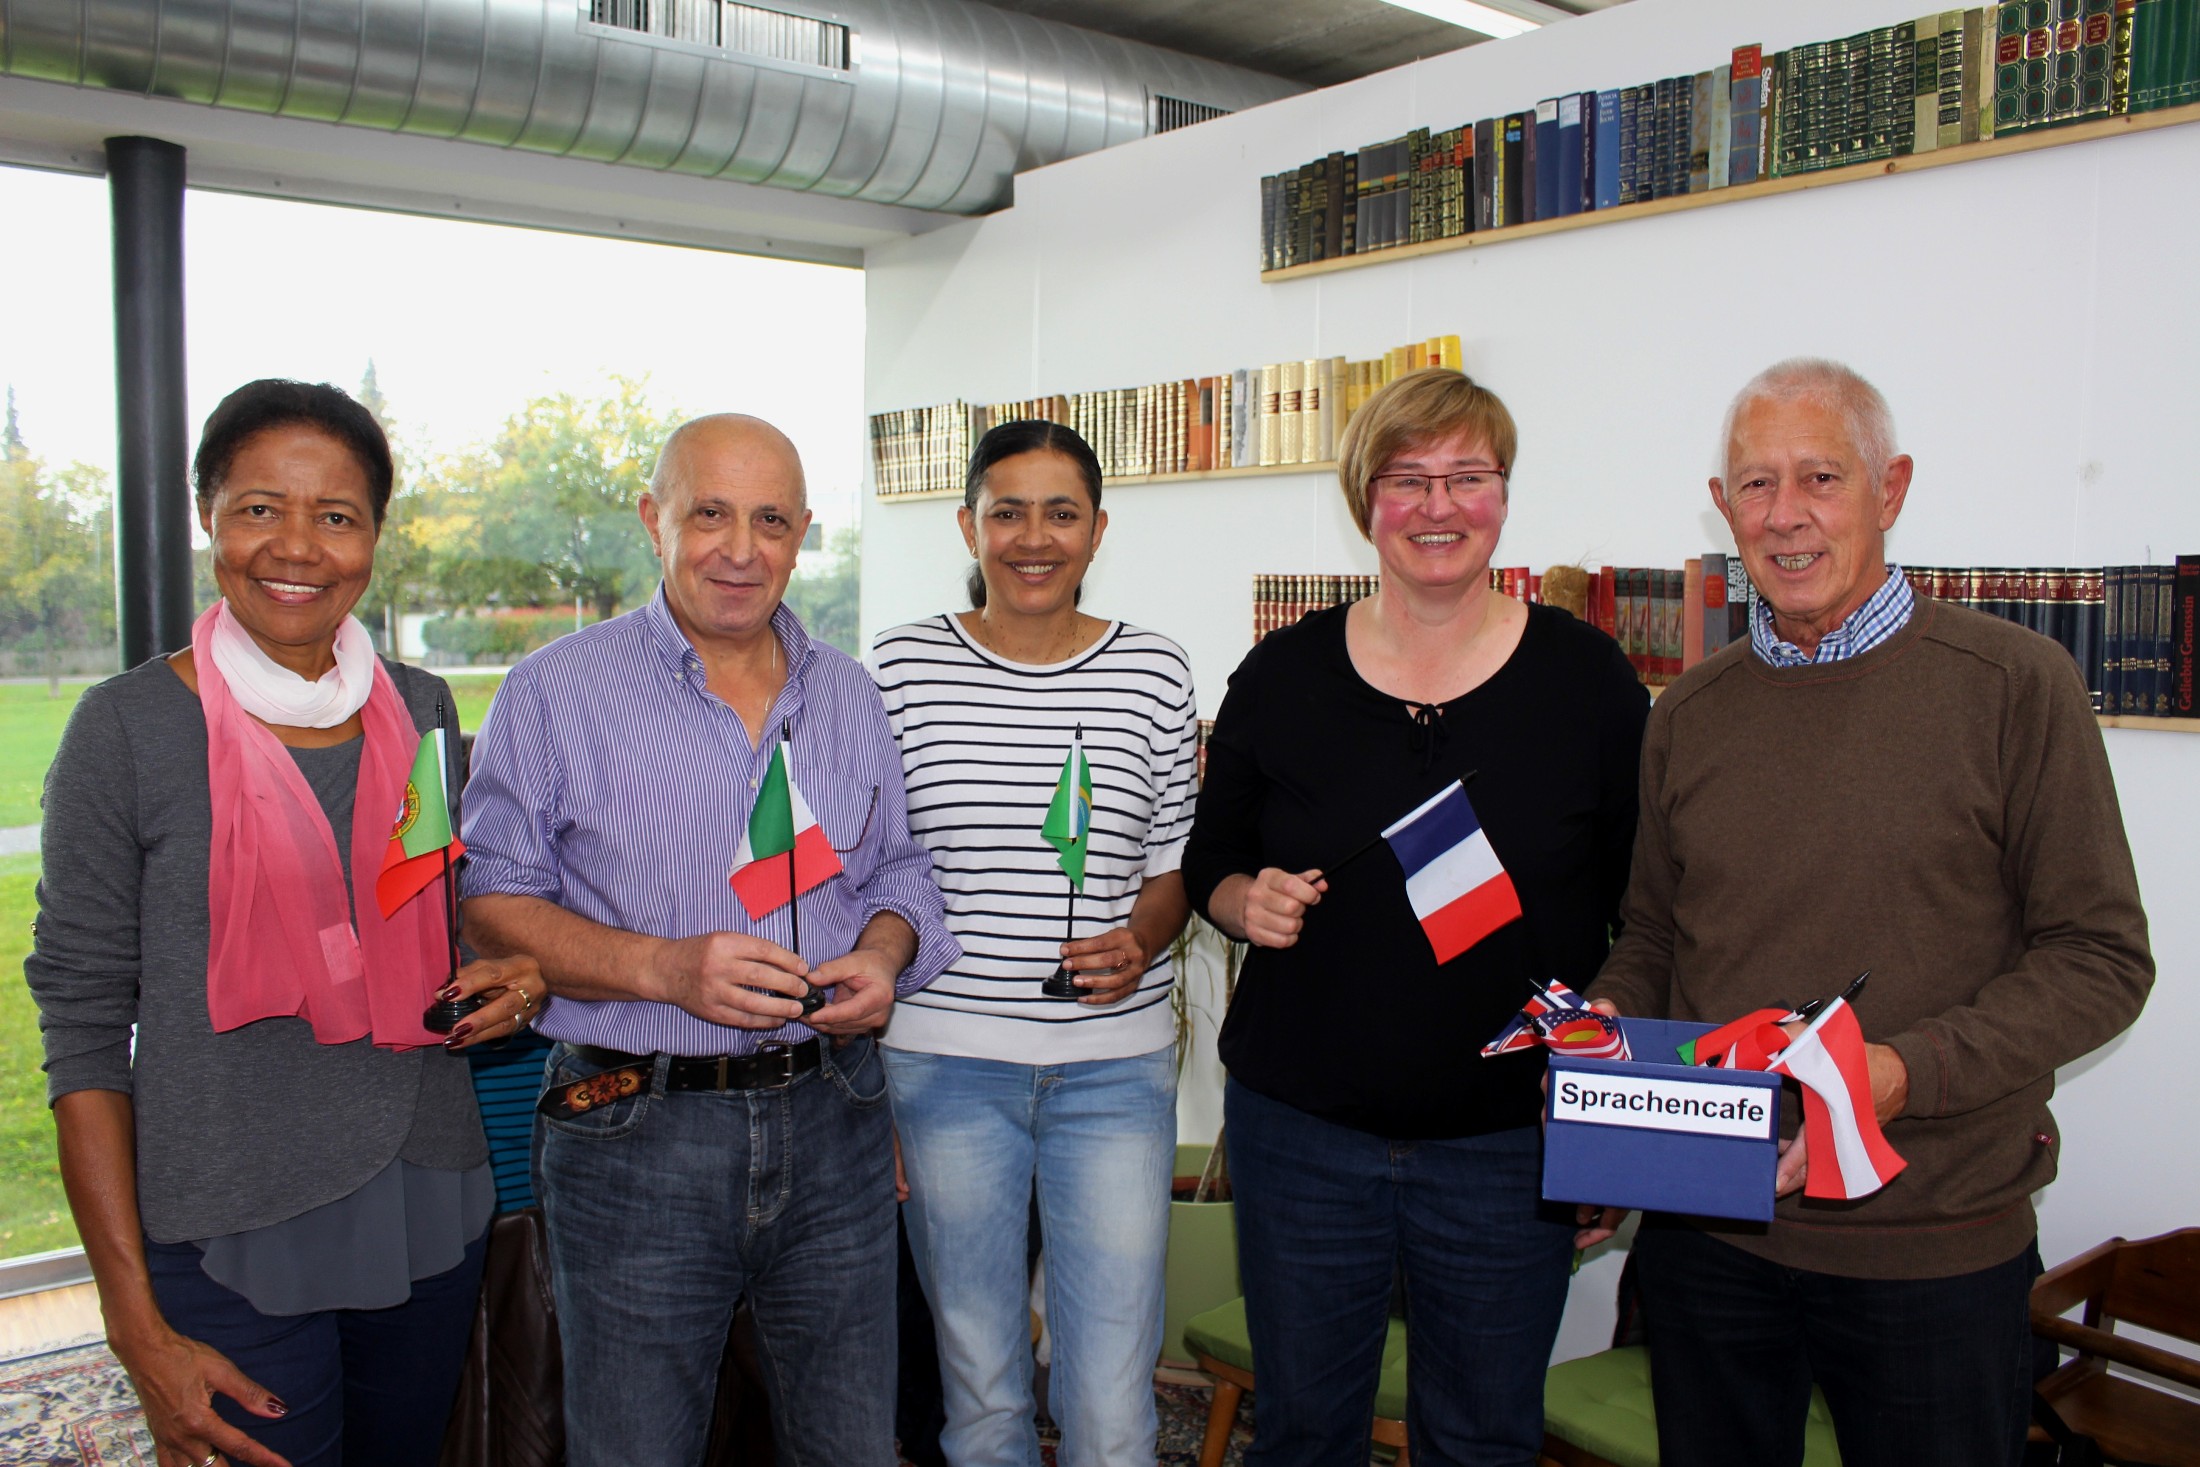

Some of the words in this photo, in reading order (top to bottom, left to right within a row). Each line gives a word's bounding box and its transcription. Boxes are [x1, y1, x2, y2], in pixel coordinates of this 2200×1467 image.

[1760, 67, 1772, 109] Stefan
[1728, 560, 1737, 586] AKTE
[1728, 586, 1737, 602] DIE
[2180, 596, 2194, 656] Genossin
[2179, 657, 2193, 711] Geliebte
[1560, 1082, 1764, 1122] Sprachencafe
